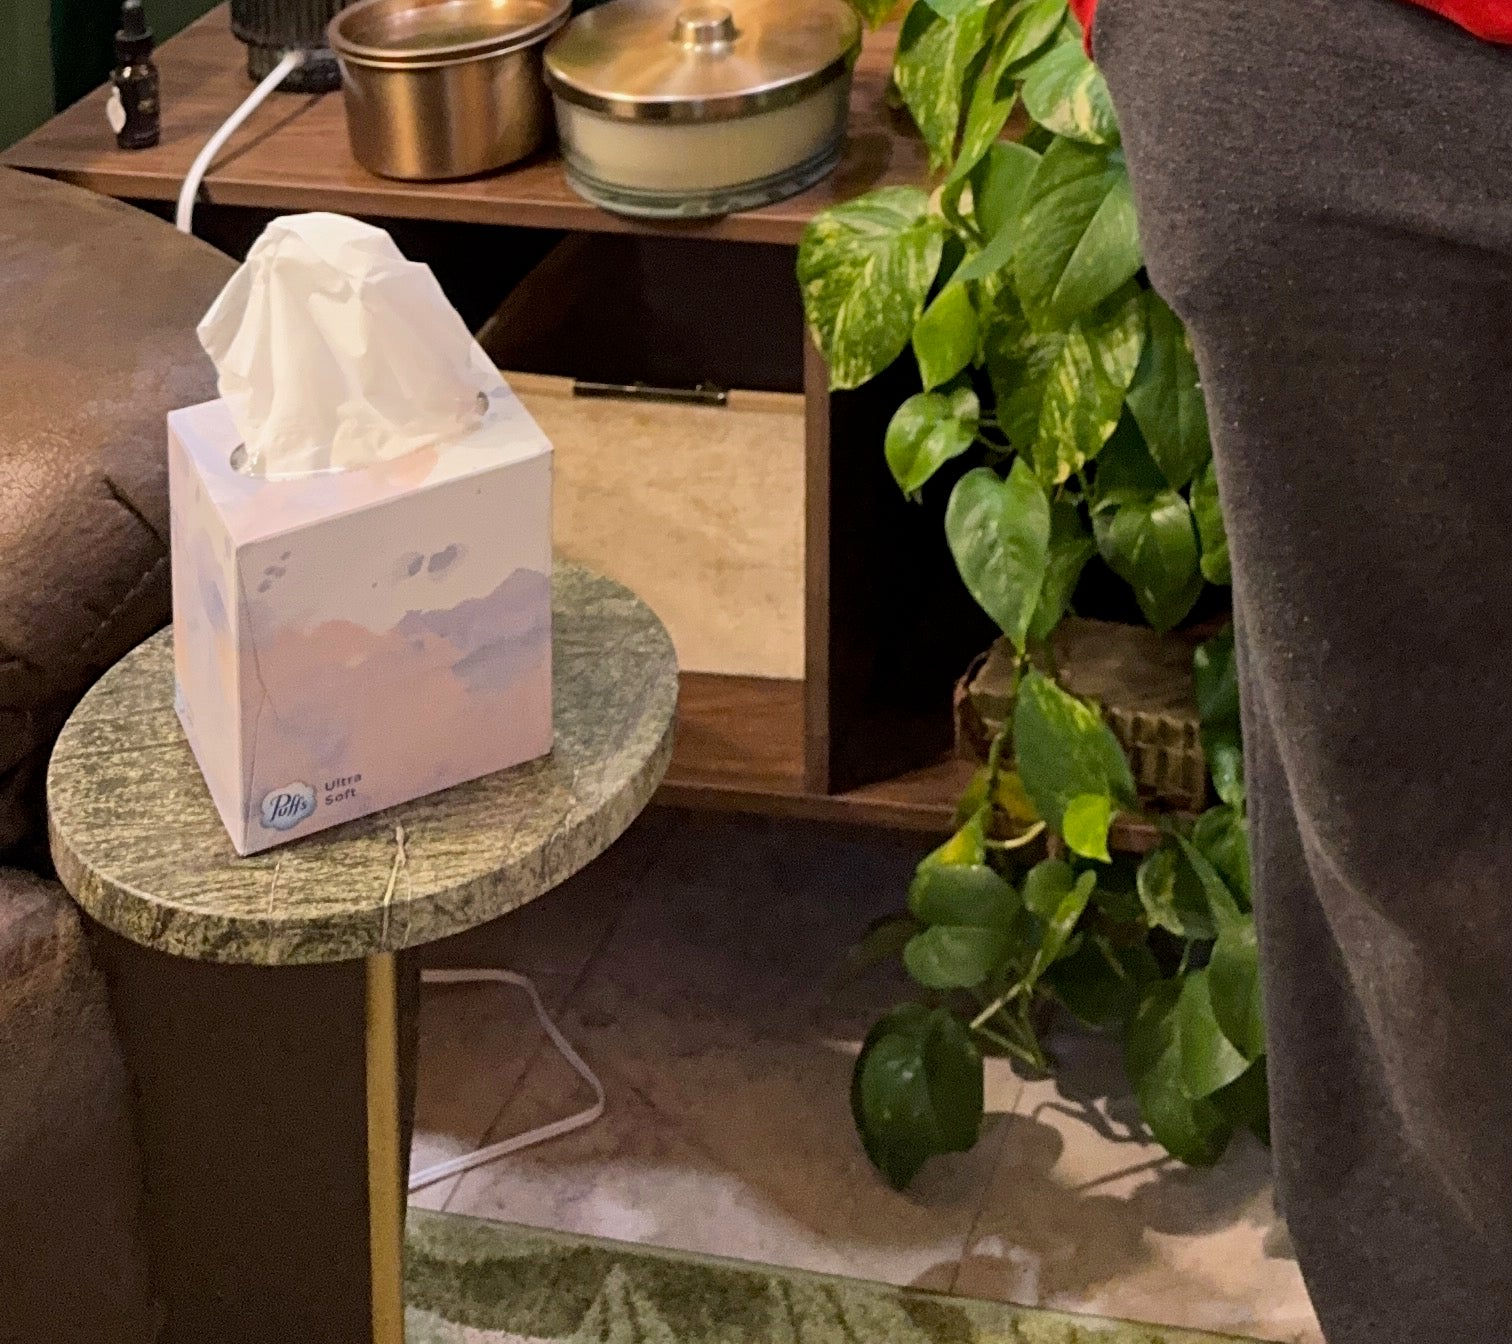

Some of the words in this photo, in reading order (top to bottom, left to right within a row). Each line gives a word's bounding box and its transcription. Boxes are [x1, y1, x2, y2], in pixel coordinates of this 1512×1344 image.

[324, 774, 362, 791] Ultra
[324, 788, 356, 806] Soft
[270, 794, 307, 823] Puffs
